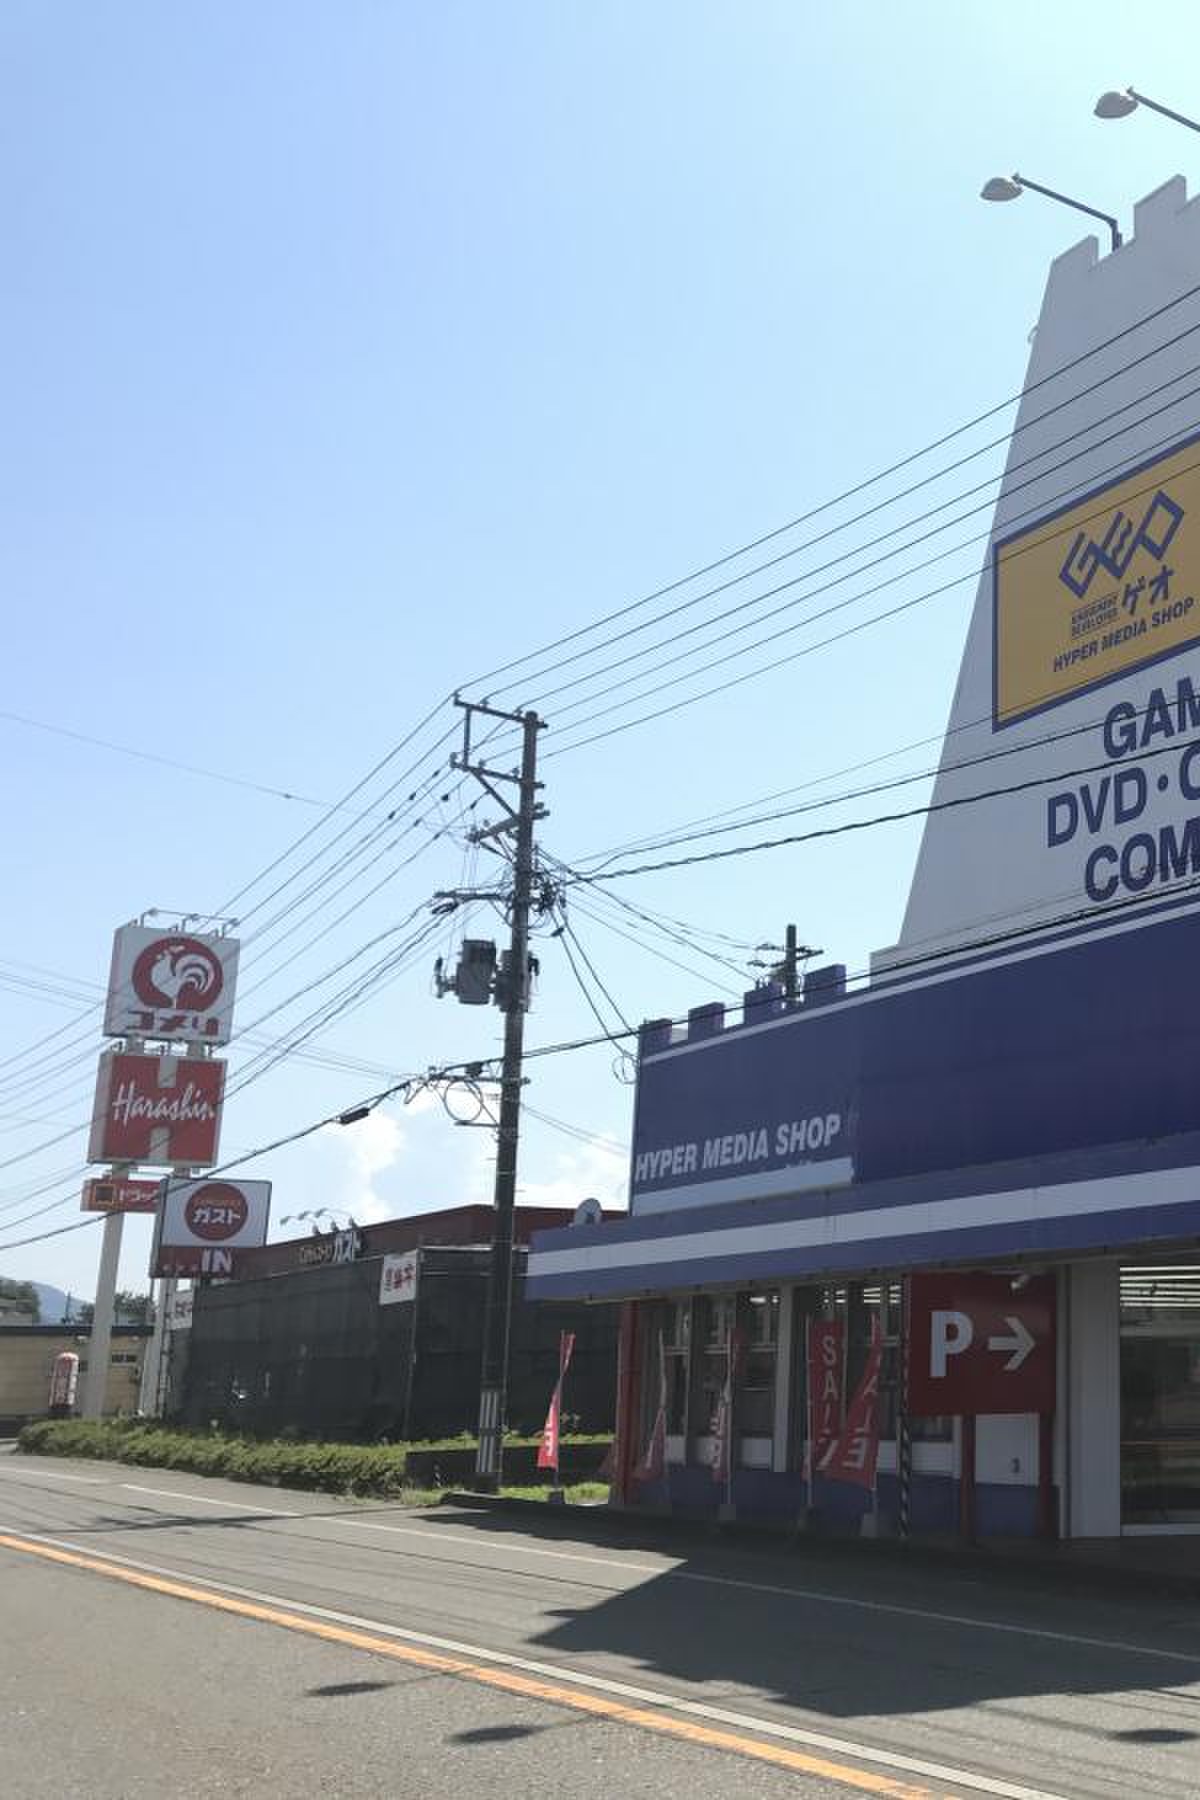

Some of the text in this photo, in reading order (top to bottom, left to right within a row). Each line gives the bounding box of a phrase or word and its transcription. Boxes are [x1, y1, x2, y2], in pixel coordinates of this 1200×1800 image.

[1060, 489, 1184, 598] GEO
[1122, 564, 1174, 616] ゲオ
[1054, 596, 1194, 672] HYPER MEDIA SHOP
[126, 1010, 219, 1036] コメリ
[112, 1080, 216, 1126] Harashin
[634, 1113, 841, 1182] HYPER MEDIA SHOP
[192, 1207, 241, 1224] ガスト
[201, 1249, 233, 1273] IN
[929, 1311, 974, 1377] P
